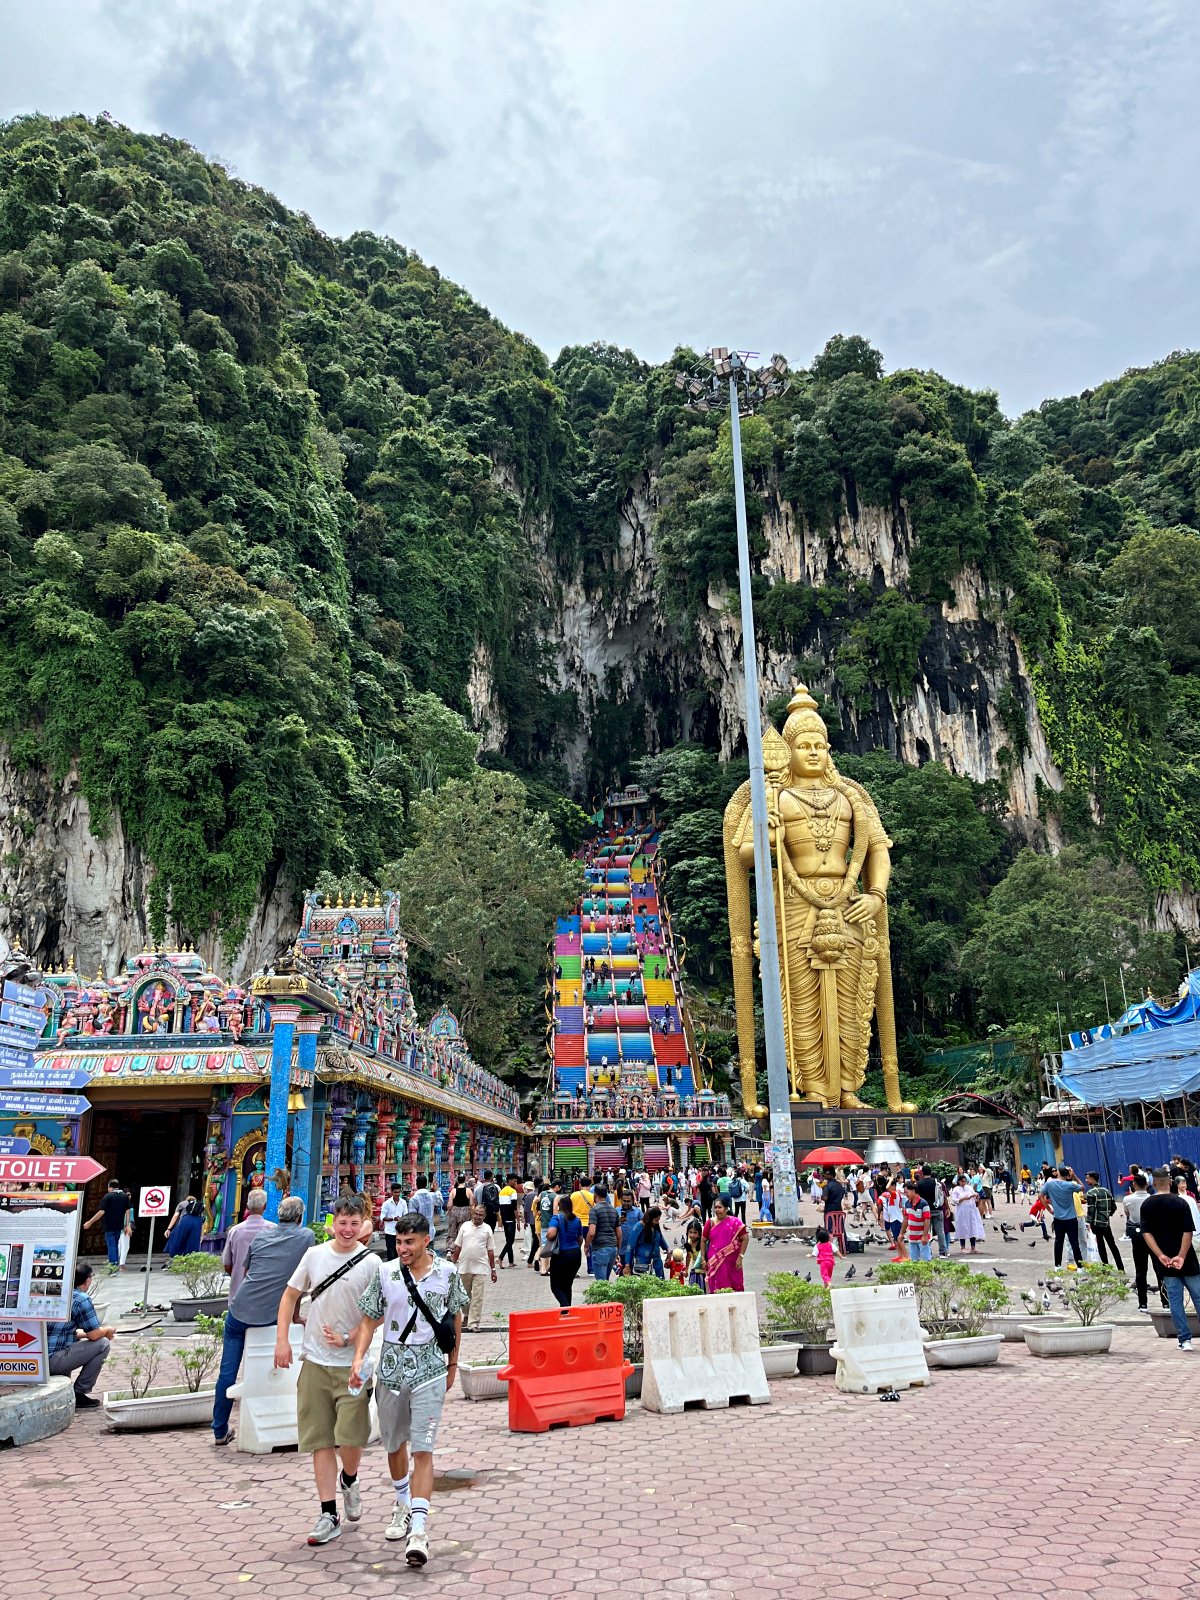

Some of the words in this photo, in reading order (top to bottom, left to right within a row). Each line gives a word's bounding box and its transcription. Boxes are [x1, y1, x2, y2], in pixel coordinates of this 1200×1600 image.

[0, 1160, 77, 1177] TOILET
[898, 1286, 915, 1298] MPS
[600, 1305, 622, 1319] MPS
